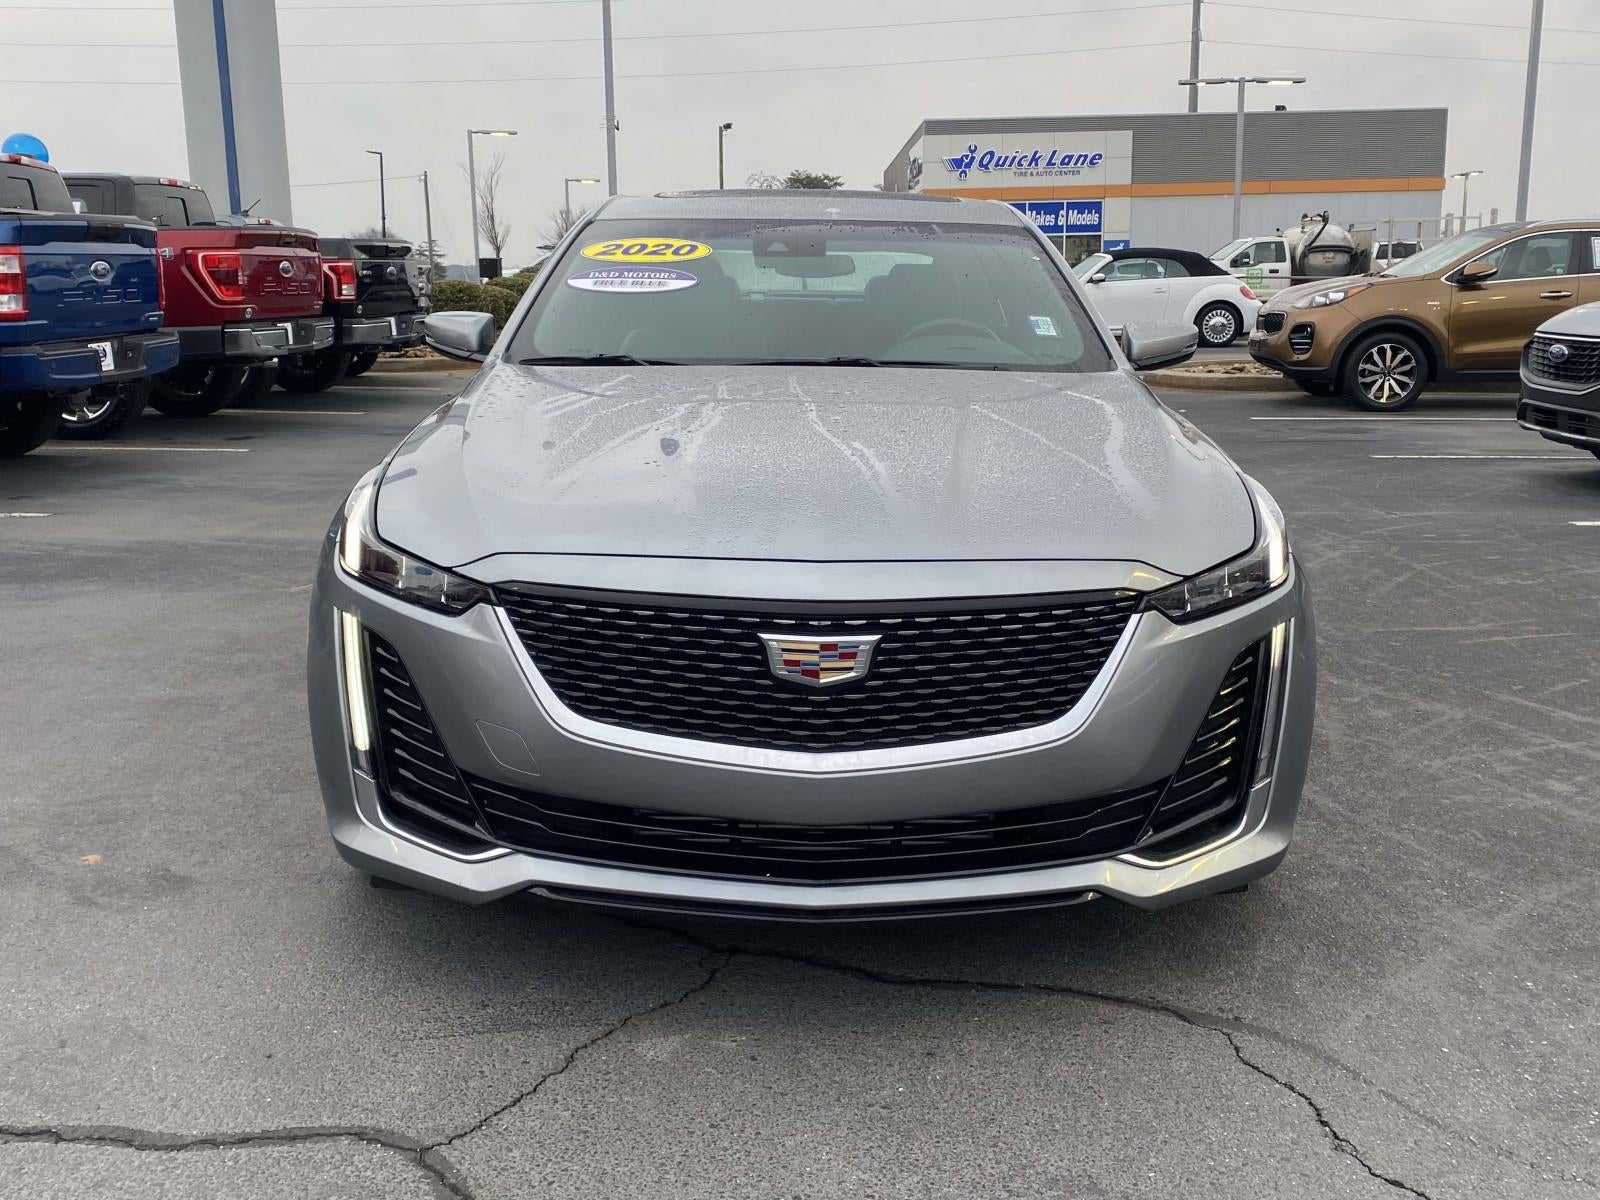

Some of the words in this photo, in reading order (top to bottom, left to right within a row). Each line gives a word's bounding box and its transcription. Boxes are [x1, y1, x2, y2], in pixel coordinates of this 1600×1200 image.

[978, 149, 1043, 171] Quick
[1045, 149, 1103, 167] Lane
[1058, 210, 1065, 226] &
[1067, 209, 1100, 225] Models
[593, 243, 700, 256] 2020
[621, 271, 677, 279] MOTORS
